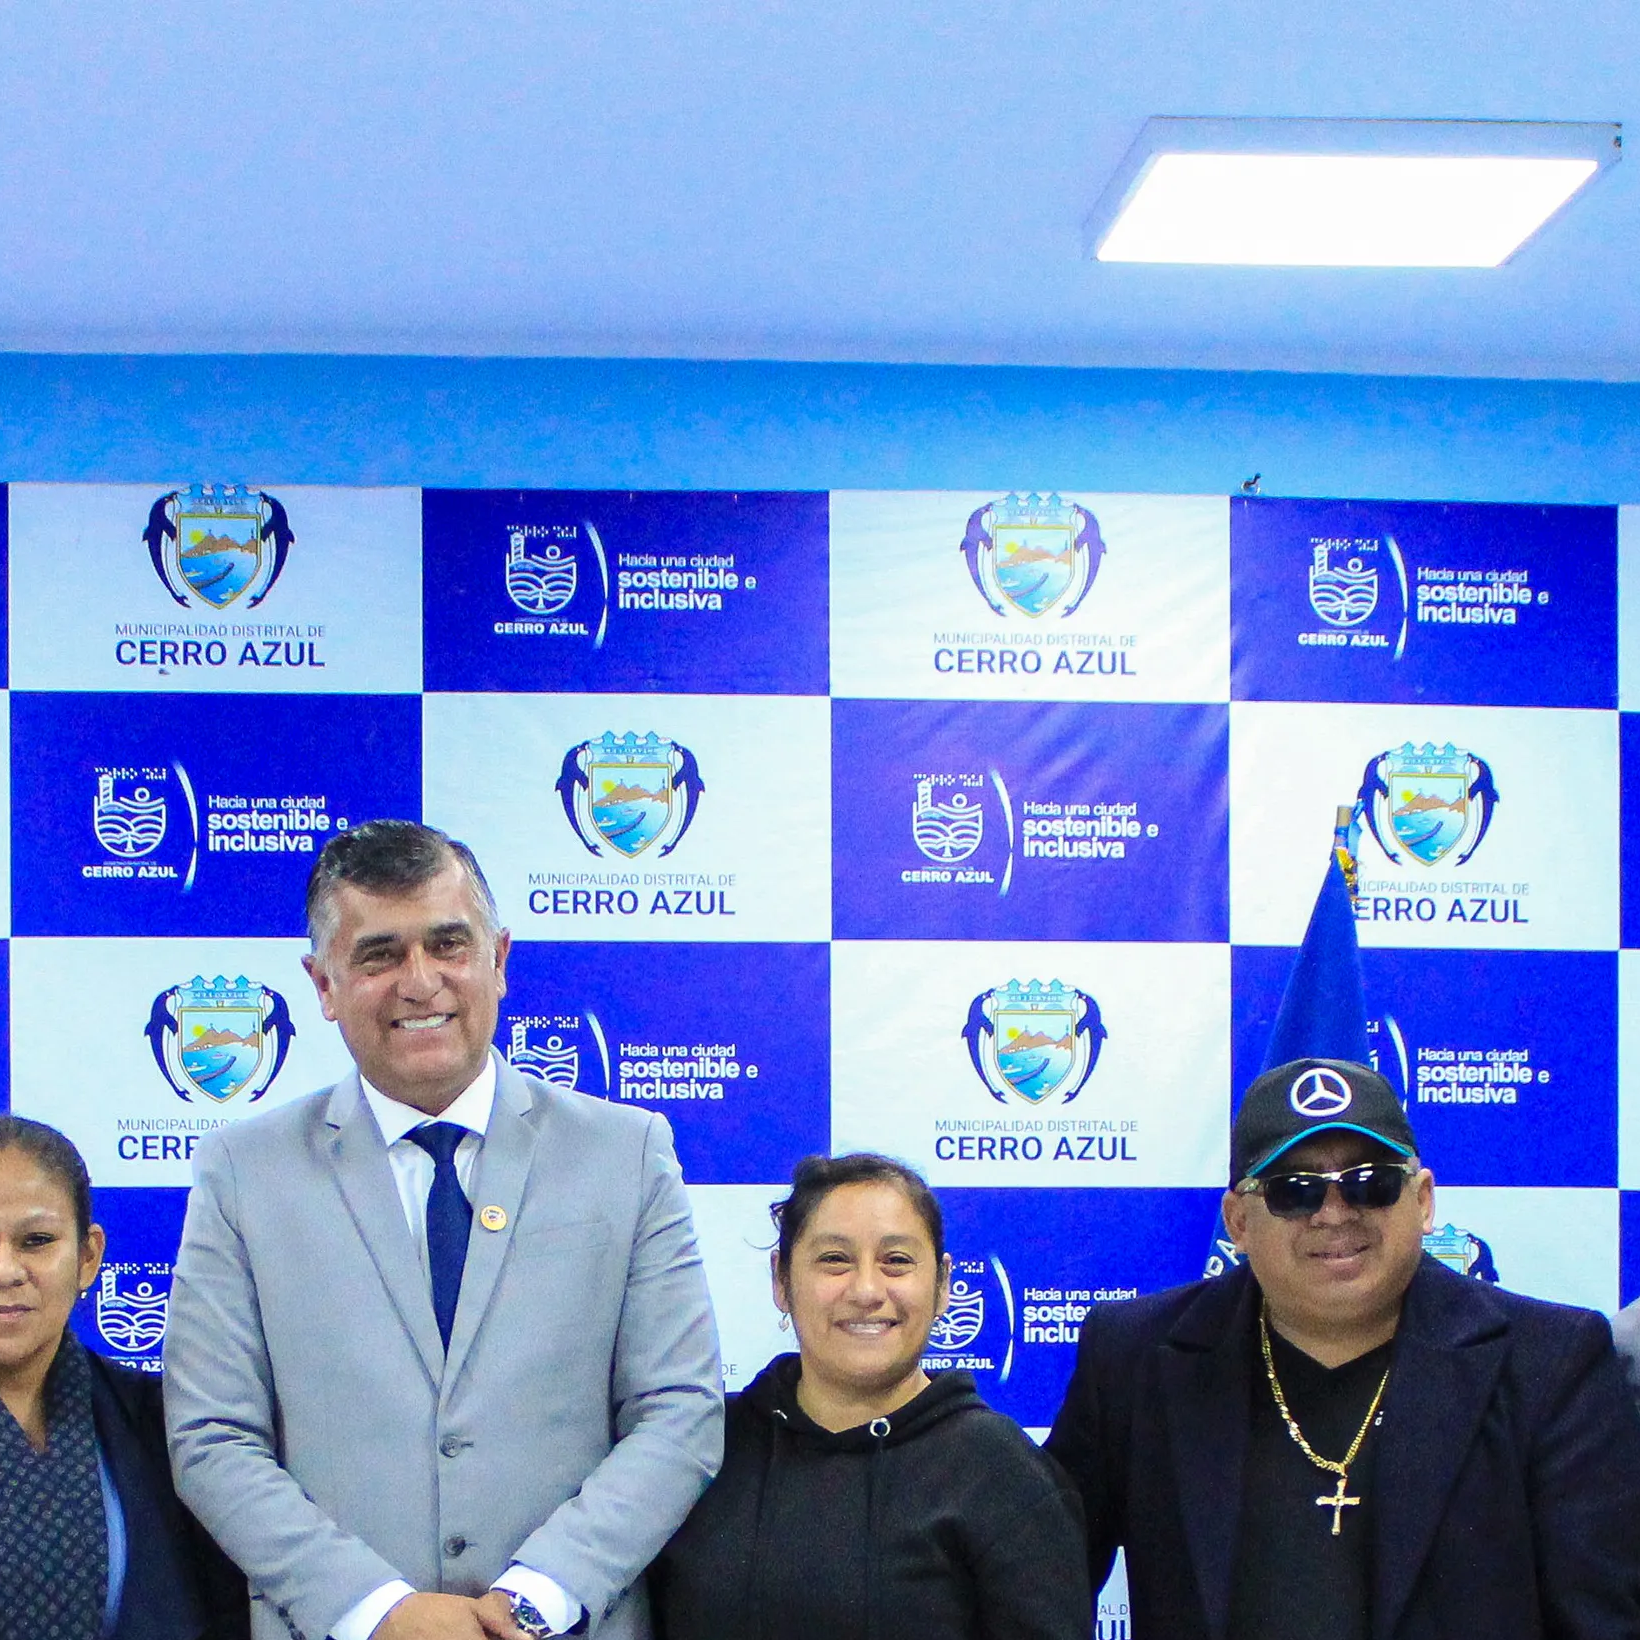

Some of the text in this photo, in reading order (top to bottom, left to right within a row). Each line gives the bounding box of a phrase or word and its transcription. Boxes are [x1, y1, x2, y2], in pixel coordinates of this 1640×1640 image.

[619, 554, 733, 570] Hacia una ciudad
[618, 568, 756, 592] sostenible e
[619, 587, 723, 610] inclusiva
[1417, 581, 1548, 606] sostenible e
[1418, 601, 1517, 624] inclusiva
[116, 624, 323, 639] MUNICIPALIDAD DISTRITAL DE
[494, 620, 544, 634] CERRO
[549, 621, 588, 635] AZUL
[934, 633, 1135, 649] MUNICIPALIDAD DISTRITAL DE
[1298, 631, 1349, 645] CERRO
[1350, 631, 1389, 646] AZUL
[116, 640, 324, 666] CERRO AZUL
[935, 648, 1135, 675] CERRO AZUL
[209, 795, 325, 811] Hacia una ciudad
[1024, 802, 1136, 818] Hacia una ciudad
[208, 809, 348, 833] sostenible e
[1023, 816, 1158, 840] sostenible e
[209, 829, 313, 851] inclusiva
[1024, 836, 1124, 858] inclusiva
[82, 864, 177, 877] CERRO AZUL
[529, 873, 734, 886] MUNICIPALIDAD DISTRITAL DE
[902, 869, 994, 882] CERRO AZUL
[1361, 881, 1529, 896] ICIPALIDAD DISTRITAL DE
[529, 890, 735, 914] CERRO AZUL
[1356, 897, 1528, 923] ERRO AZUL
[620, 1043, 735, 1060] Hacia una ciudad
[1418, 1048, 1528, 1064] Hacia una ciudad
[620, 1057, 758, 1081] sostenible e
[1417, 1061, 1549, 1086] sostenible e
[621, 1077, 723, 1099] inclusiva
[1418, 1082, 1516, 1103] inclusiva
[936, 1120, 1137, 1132] MUNICIPALIDAD DISTRITAL DE
[117, 1135, 200, 1161] CERR
[936, 1136, 1136, 1160] CERRO AZUL
[1024, 1288, 1137, 1301] Hacia una ciudad
[956, 1359, 994, 1370] AZUL
